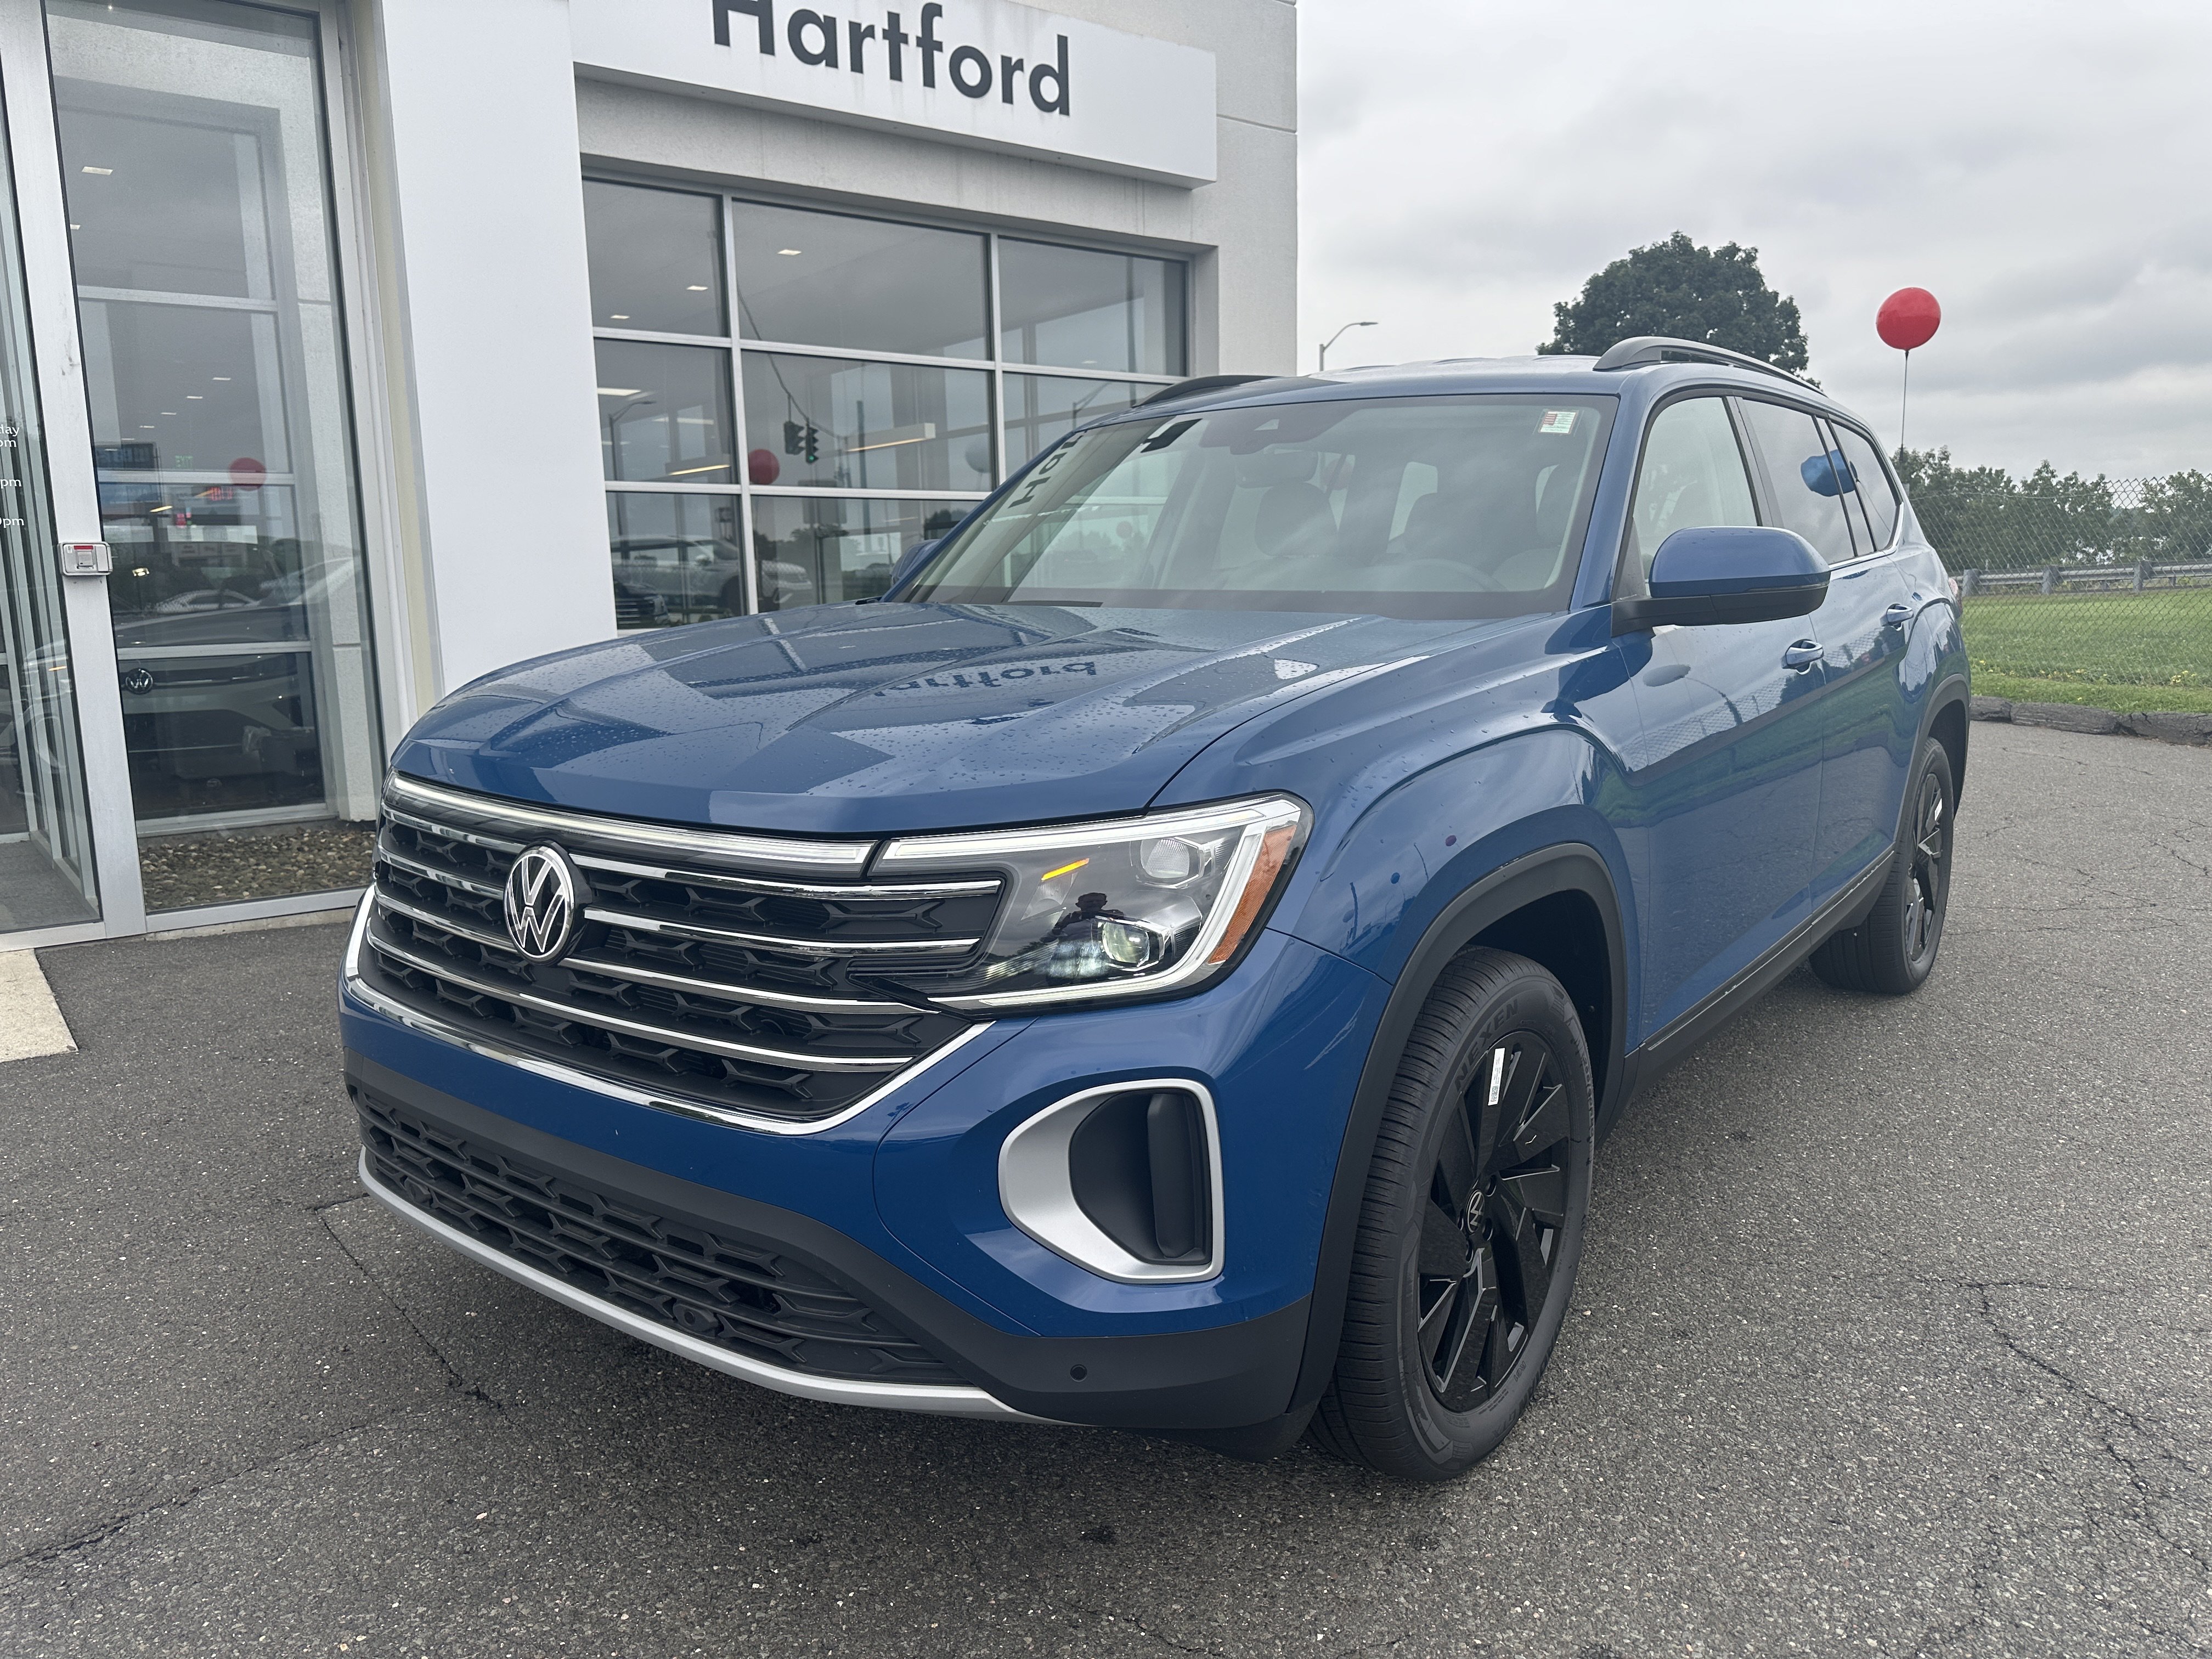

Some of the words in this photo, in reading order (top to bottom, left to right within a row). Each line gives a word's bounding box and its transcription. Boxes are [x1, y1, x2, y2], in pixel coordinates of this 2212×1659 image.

[713, 0, 1070, 117] Hartford
[0, 517, 25, 528] pm
[505, 852, 568, 958] VW
[1455, 999, 1518, 1092] NEXEN
